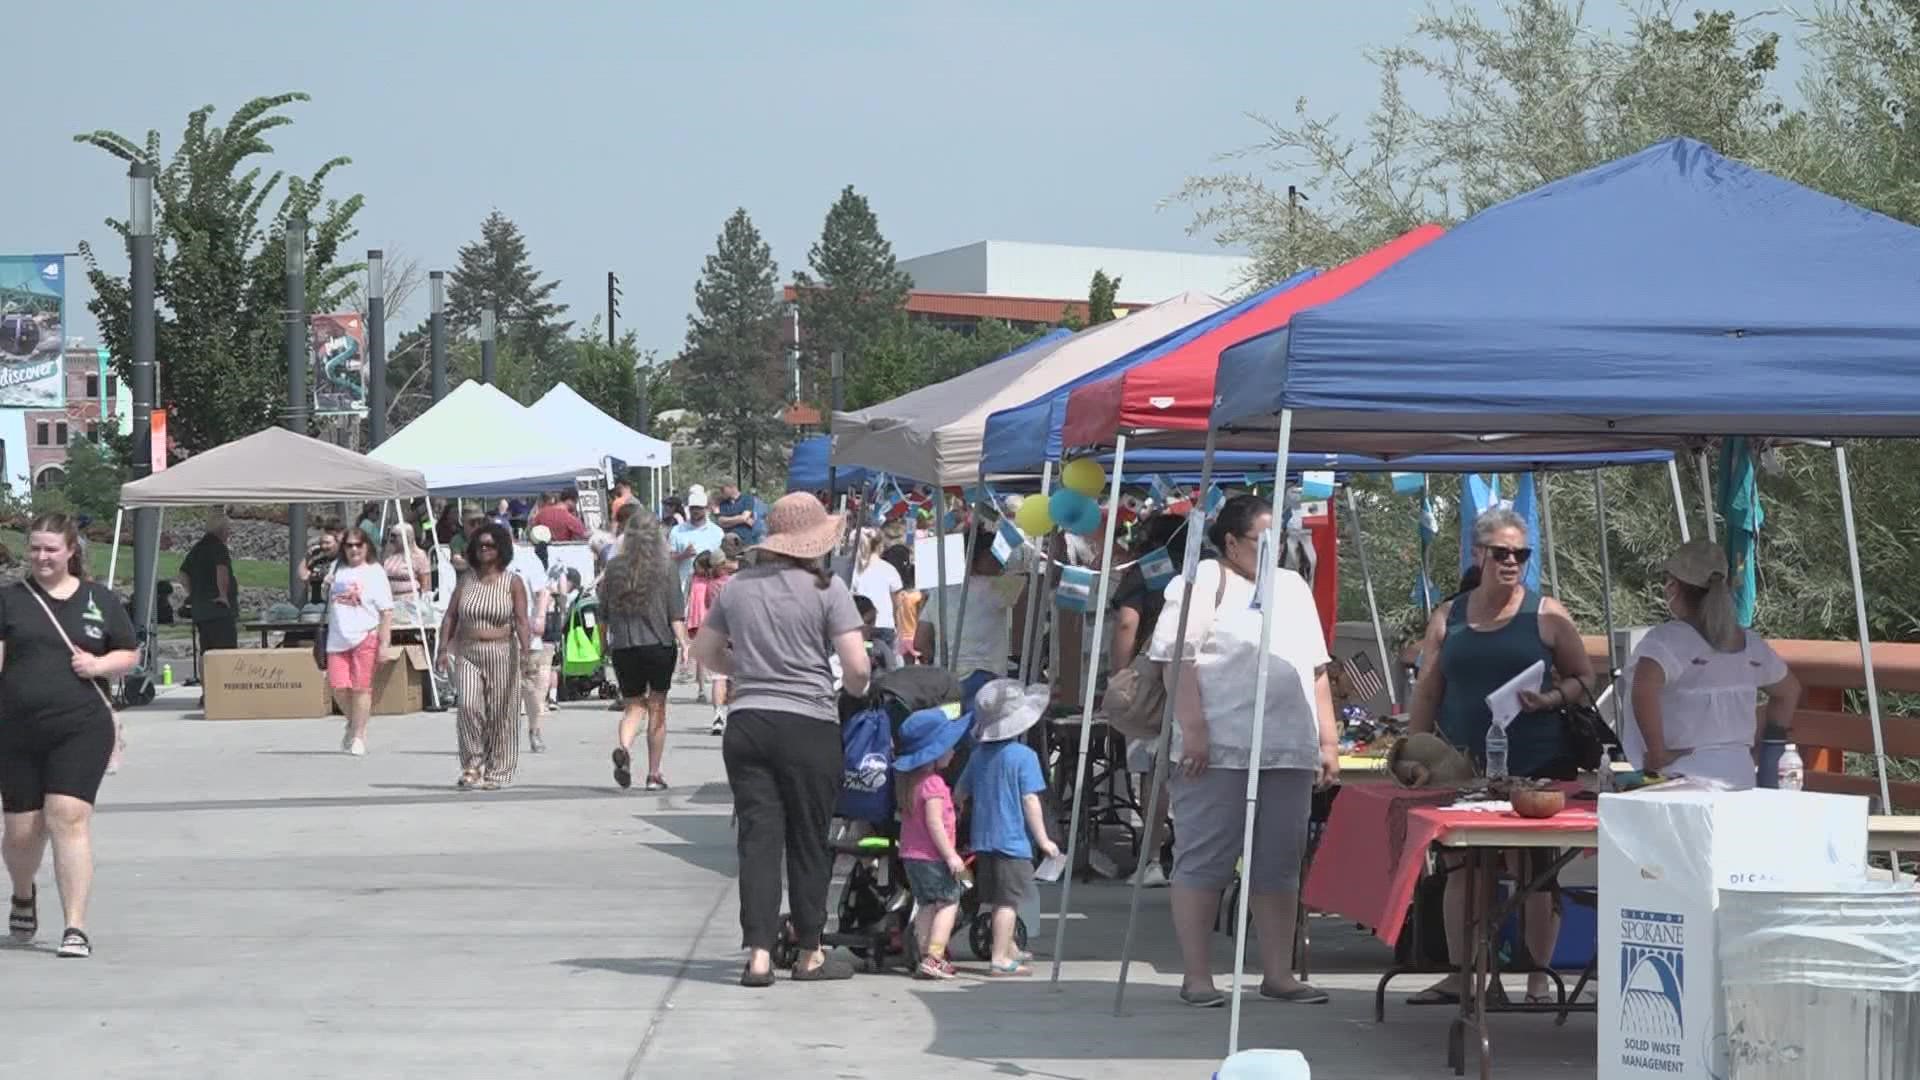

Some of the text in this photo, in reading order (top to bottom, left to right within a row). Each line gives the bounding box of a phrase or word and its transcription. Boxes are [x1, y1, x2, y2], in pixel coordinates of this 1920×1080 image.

[0, 360, 54, 386] discover
[1622, 911, 1682, 923] CITY OF
[1621, 920, 1684, 944] SPOKANE
[1624, 1038, 1680, 1056] SOLID WASTE
[1621, 1054, 1684, 1072] MANAGEMENT
